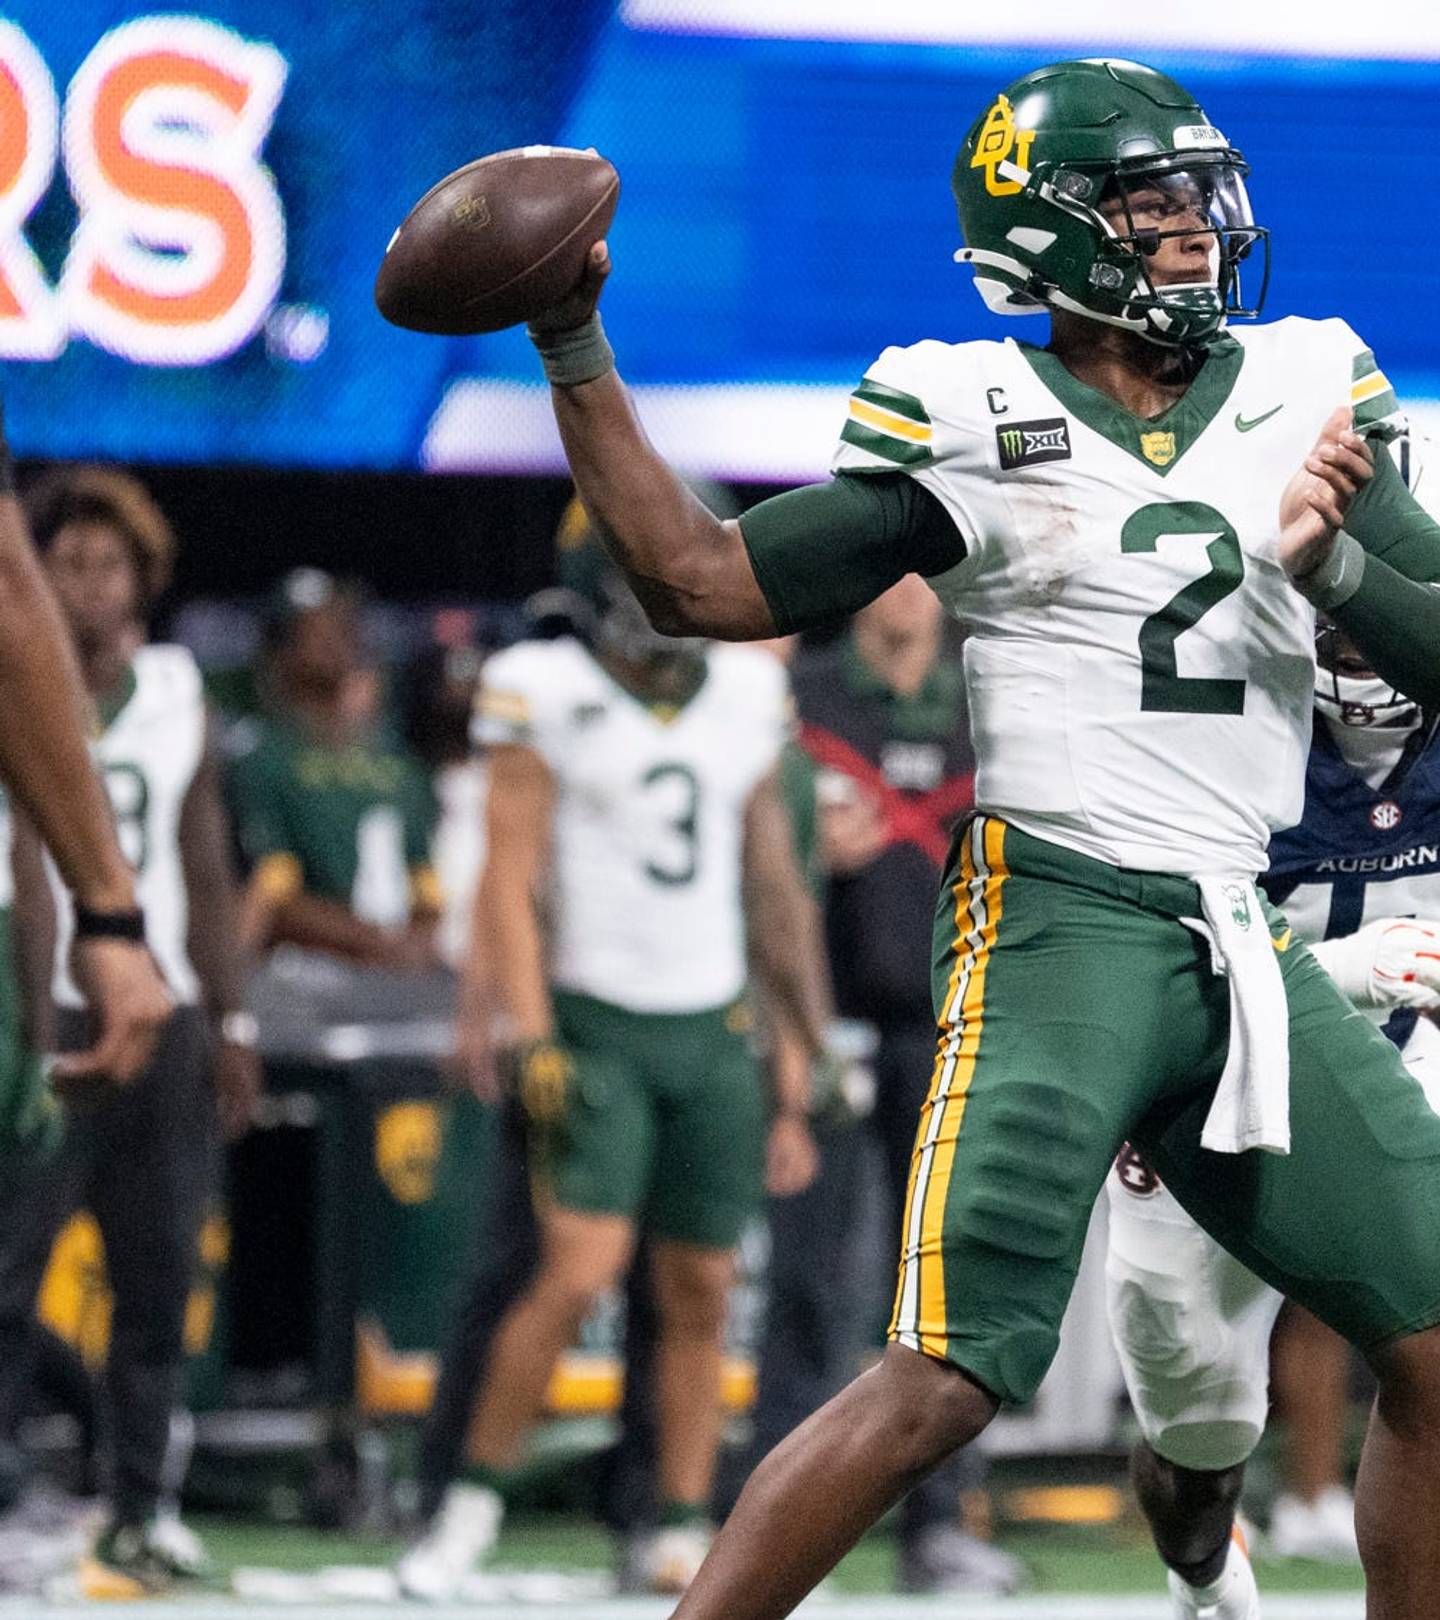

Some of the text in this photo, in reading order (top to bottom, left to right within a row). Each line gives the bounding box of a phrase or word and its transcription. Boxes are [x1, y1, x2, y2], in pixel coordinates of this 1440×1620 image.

[986, 387, 1008, 415] C
[1120, 501, 1244, 715] 2
[643, 759, 698, 888] 3
[1372, 803, 1401, 829] SEC
[1316, 845, 1439, 873] AUBURN
